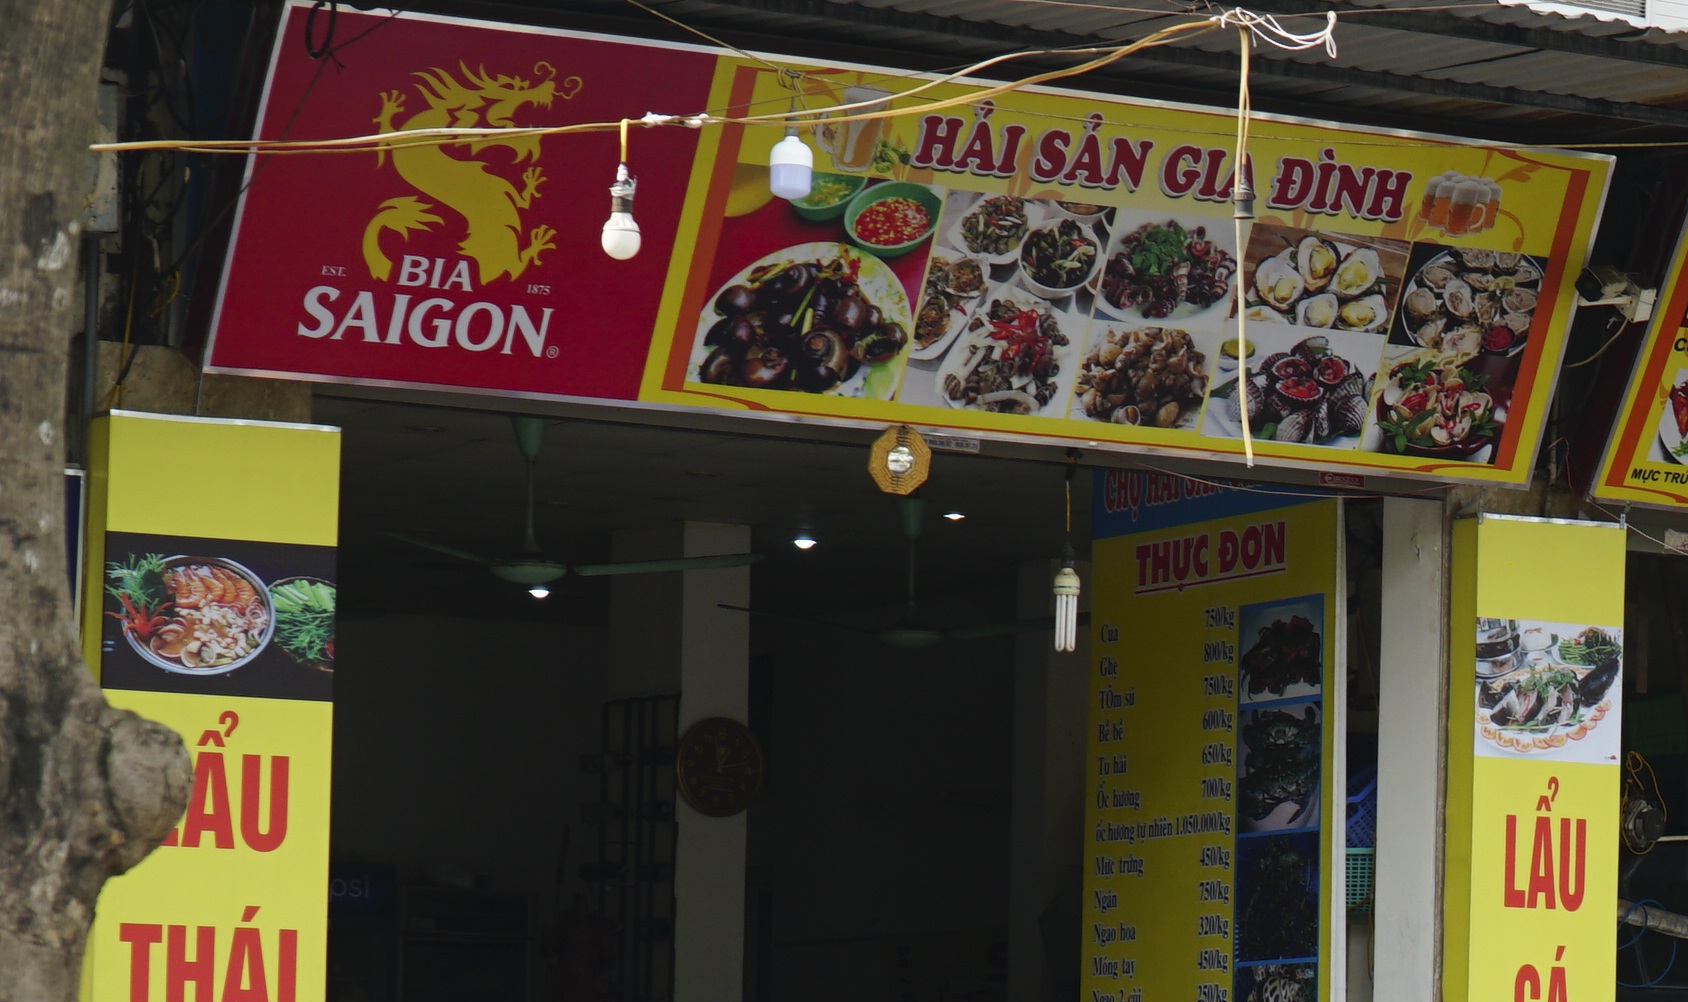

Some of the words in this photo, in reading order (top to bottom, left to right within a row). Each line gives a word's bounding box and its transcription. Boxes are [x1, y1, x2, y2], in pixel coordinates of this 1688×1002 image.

[914, 102, 1025, 174] HẢI
[1033, 114, 1153, 191] SẢN
[1163, 146, 1256, 202] GIA
[1272, 149, 1411, 221] ĐÌNH
[397, 254, 473, 292] BIA
[526, 283, 551, 296] 1875
[297, 285, 555, 358] SAIGON
[1631, 466, 1660, 486] MỰC
[1135, 533, 1208, 589] THỰC
[1217, 521, 1286, 573] ĐƠN
[1204, 606, 1234, 629] 750/kg
[1101, 624, 1118, 643] Cua
[1204, 641, 1234, 664] 800/kg
[1100, 657, 1117, 680] Ghẹ
[1125, 688, 1135, 708] sú
[1203, 675, 1234, 698] 750/kg
[1202, 710, 1232, 731] 600/kg
[1201, 744, 1232, 766] 650/kg
[159, 710, 290, 853] ẨU
[1201, 779, 1231, 799] 700/kg
[1096, 783, 1109, 809] Ốc
[1148, 816, 1173, 838] nhiên
[1504, 776, 1587, 912] LẨU
[1096, 856, 1115, 879] Mực
[1200, 845, 1230, 869] 450/kg
[1094, 889, 1117, 914] Ngán
[1198, 880, 1229, 904] 750/kg
[1093, 923, 1116, 949] Ngao
[1119, 922, 1136, 941] hoa
[1198, 915, 1229, 938] 320/kg
[1093, 956, 1118, 980] Móng
[1121, 958, 1136, 979] tay
[1197, 950, 1228, 973] 450/kg
